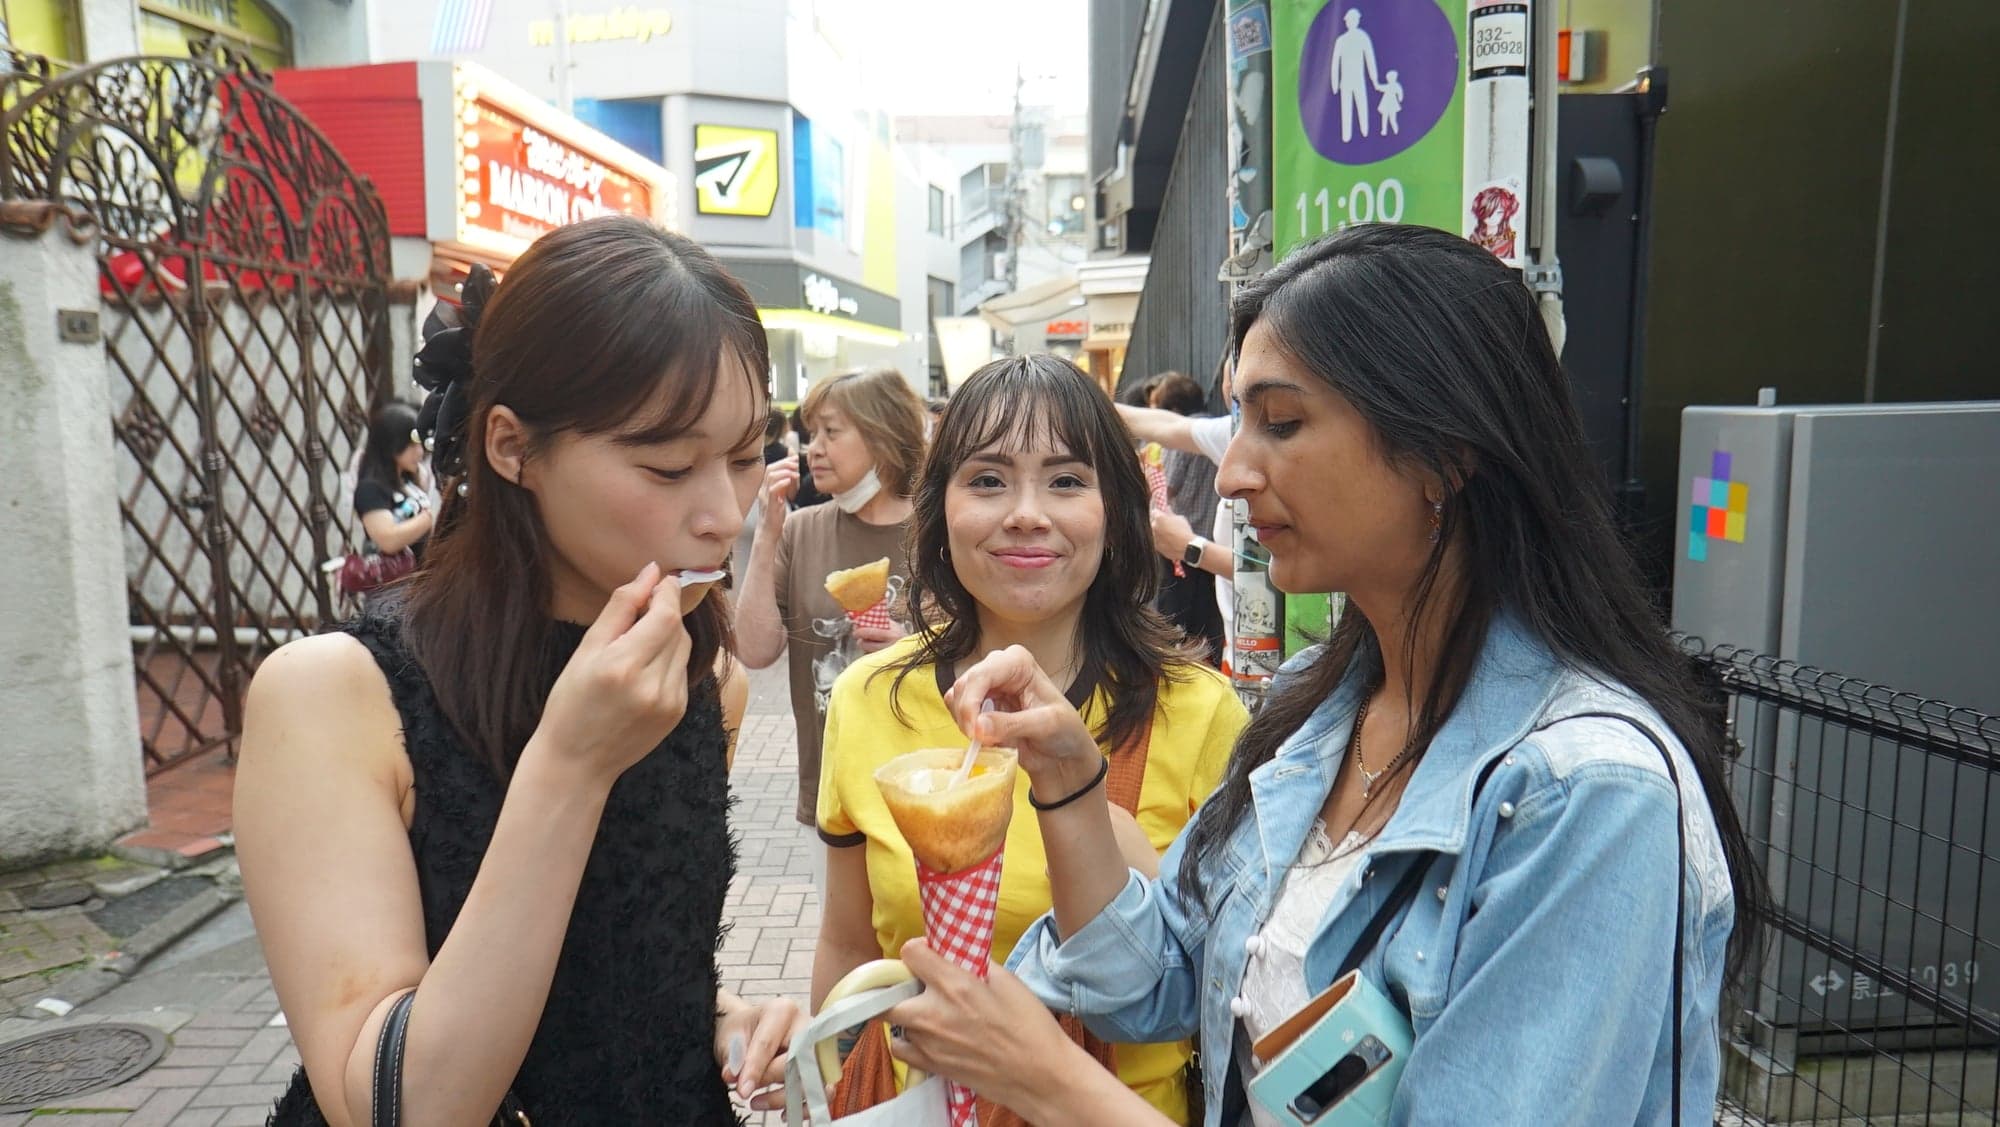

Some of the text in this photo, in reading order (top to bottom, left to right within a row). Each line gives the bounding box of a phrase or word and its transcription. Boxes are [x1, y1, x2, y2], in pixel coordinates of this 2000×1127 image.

[1476, 27, 1512, 43] 332-
[1476, 41, 1522, 57] 000928
[489, 160, 569, 226] MARION
[1296, 178, 1404, 238] 11:00
